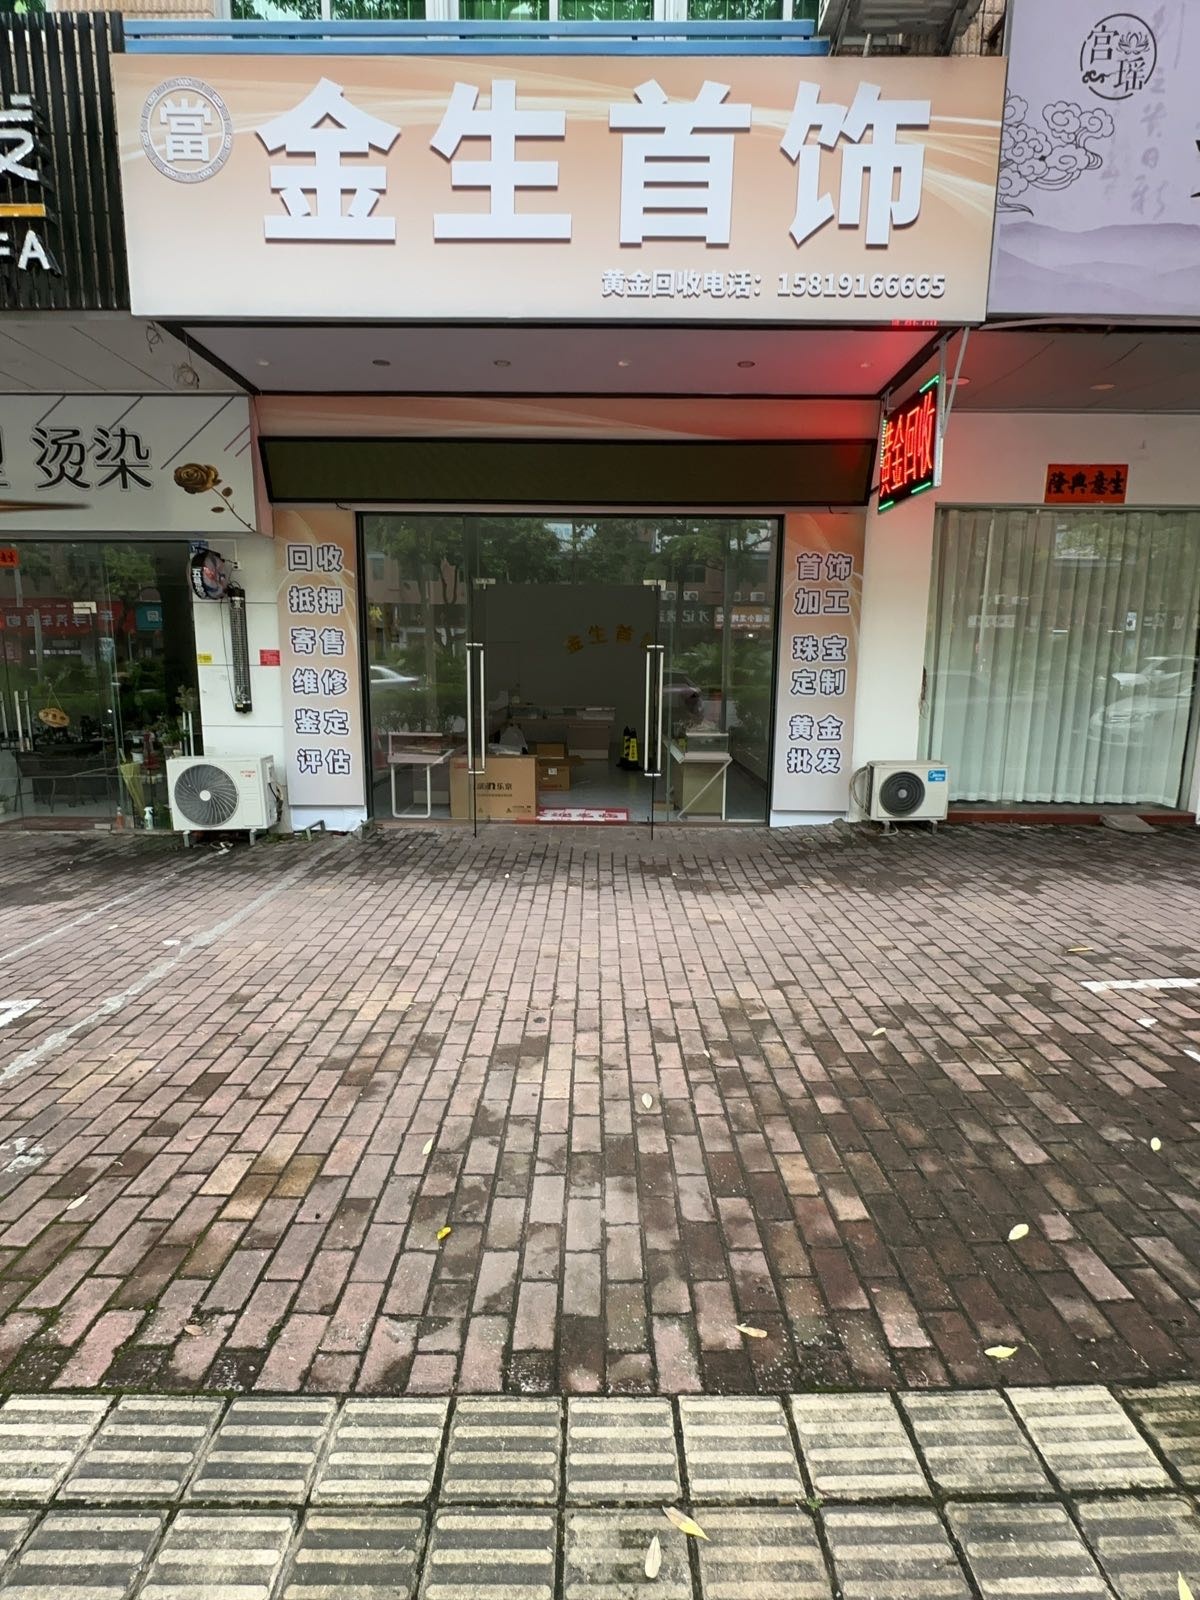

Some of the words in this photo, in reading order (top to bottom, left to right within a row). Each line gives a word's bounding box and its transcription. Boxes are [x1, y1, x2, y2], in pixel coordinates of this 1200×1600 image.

[255, 77, 931, 248] 金生首饰
[32, 427, 152, 489] 烫染
[879, 391, 936, 497] 黄金回收
[287, 544, 343, 572] 回收
[796, 552, 853, 581] 首饰
[288, 585, 344, 614] 抵押
[793, 587, 850, 615] 加工
[290, 627, 345, 656] 寄售
[792, 634, 848, 662] 珠宝
[292, 667, 348, 696] 维修
[790, 668, 846, 696] 定制
[294, 708, 349, 736] 鉴定
[788, 714, 844, 741] 黄金
[296, 747, 351, 775] 评估
[786, 747, 841, 774] 批发
